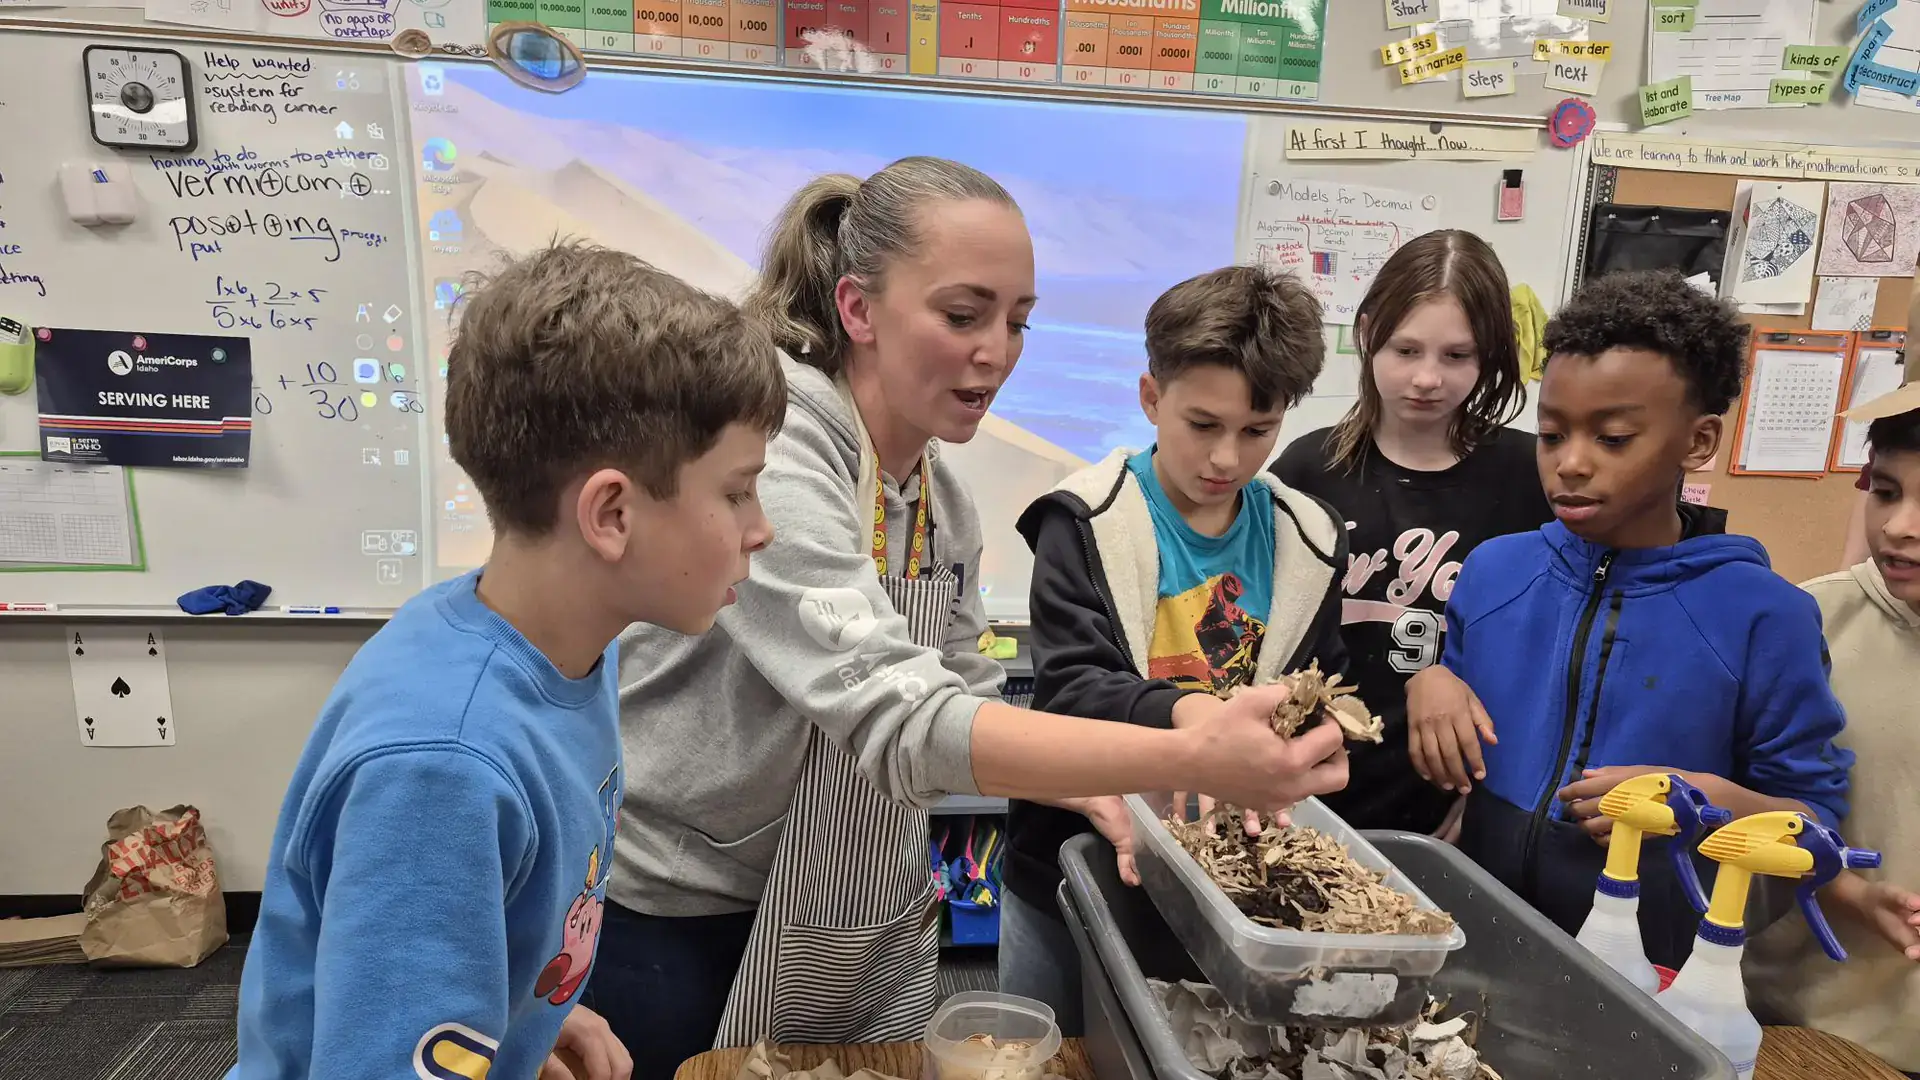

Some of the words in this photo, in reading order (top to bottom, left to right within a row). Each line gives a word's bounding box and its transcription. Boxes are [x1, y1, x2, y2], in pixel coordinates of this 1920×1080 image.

[540, 3, 581, 13] 10,000,000
[592, 8, 627, 17] 1,000,000
[787, 2, 824, 11] Hundreds
[840, 4, 857, 13] Tens
[878, 7, 898, 15] Ones
[637, 9, 679, 23] 100,000
[688, 14, 724, 27] 10,000
[739, 19, 768, 31] 1,000
[958, 11, 983, 21] Tenths
[1008, 15, 1051, 26] Hundredths
[1661, 12, 1686, 24] sort
[1162, 21, 1191, 30] Hundred
[1204, 28, 1235, 37] Millionths
[334, 27, 391, 39] overlaps
[1257, 29, 1268, 37] Ten
[964, 36, 974, 49] .1
[1572, 43, 1610, 55] order
[1075, 42, 1096, 53] .001
[1116, 45, 1143, 56] .0001
[1157, 47, 1190, 59] .00001
[1202, 51, 1233, 61] .000001
[204, 51, 240, 71] Help
[1790, 53, 1820, 66] kinds
[1823, 55, 1840, 67] of
[97, 72, 107, 80] 50
[1554, 63, 1589, 82] next
[94, 92, 104, 100] 45
[279, 82, 304, 98] for
[1645, 89, 1658, 103] list
[1660, 84, 1680, 99] and
[1774, 82, 1807, 97] types
[1810, 83, 1826, 95] of
[1704, 93, 1722, 102] Tree
[1723, 93, 1742, 103] Map
[209, 98, 278, 125] reading
[1644, 100, 1688, 118] elaborate
[138, 133, 148, 141] 30
[157, 129, 167, 137] 25
[1290, 128, 1307, 151] At
[1312, 127, 1347, 150] first
[1354, 130, 1368, 150] I
[235, 145, 258, 161] do
[1592, 135, 1612, 158] We
[1615, 148, 1634, 159] are
[1640, 144, 1682, 168] learning
[1687, 147, 1698, 163] to
[1705, 147, 1728, 165] think
[1730, 150, 1747, 166] and
[1806, 158, 1889, 177] mathematicians
[1897, 166, 1909, 177] so
[150, 155, 212, 174] having
[290, 147, 379, 169] together
[1280, 183, 1329, 204] Models
[1337, 188, 1356, 204] for
[1362, 191, 1413, 210] Decimal
[1257, 220, 1304, 238] Algorithm
[1317, 224, 1354, 236] Decimal
[189, 239, 223, 262] put
[136, 354, 199, 369] AmeriCorps
[136, 365, 160, 374] Idaho
[306, 361, 338, 384] 10
[98, 391, 168, 407] SERVING
[172, 395, 211, 410] HERE
[308, 389, 359, 423] 30
[391, 531, 413, 541] OFF
[74, 632, 83, 645] A
[147, 632, 156, 645] A
[86, 727, 96, 740] A
[158, 727, 167, 740] A
